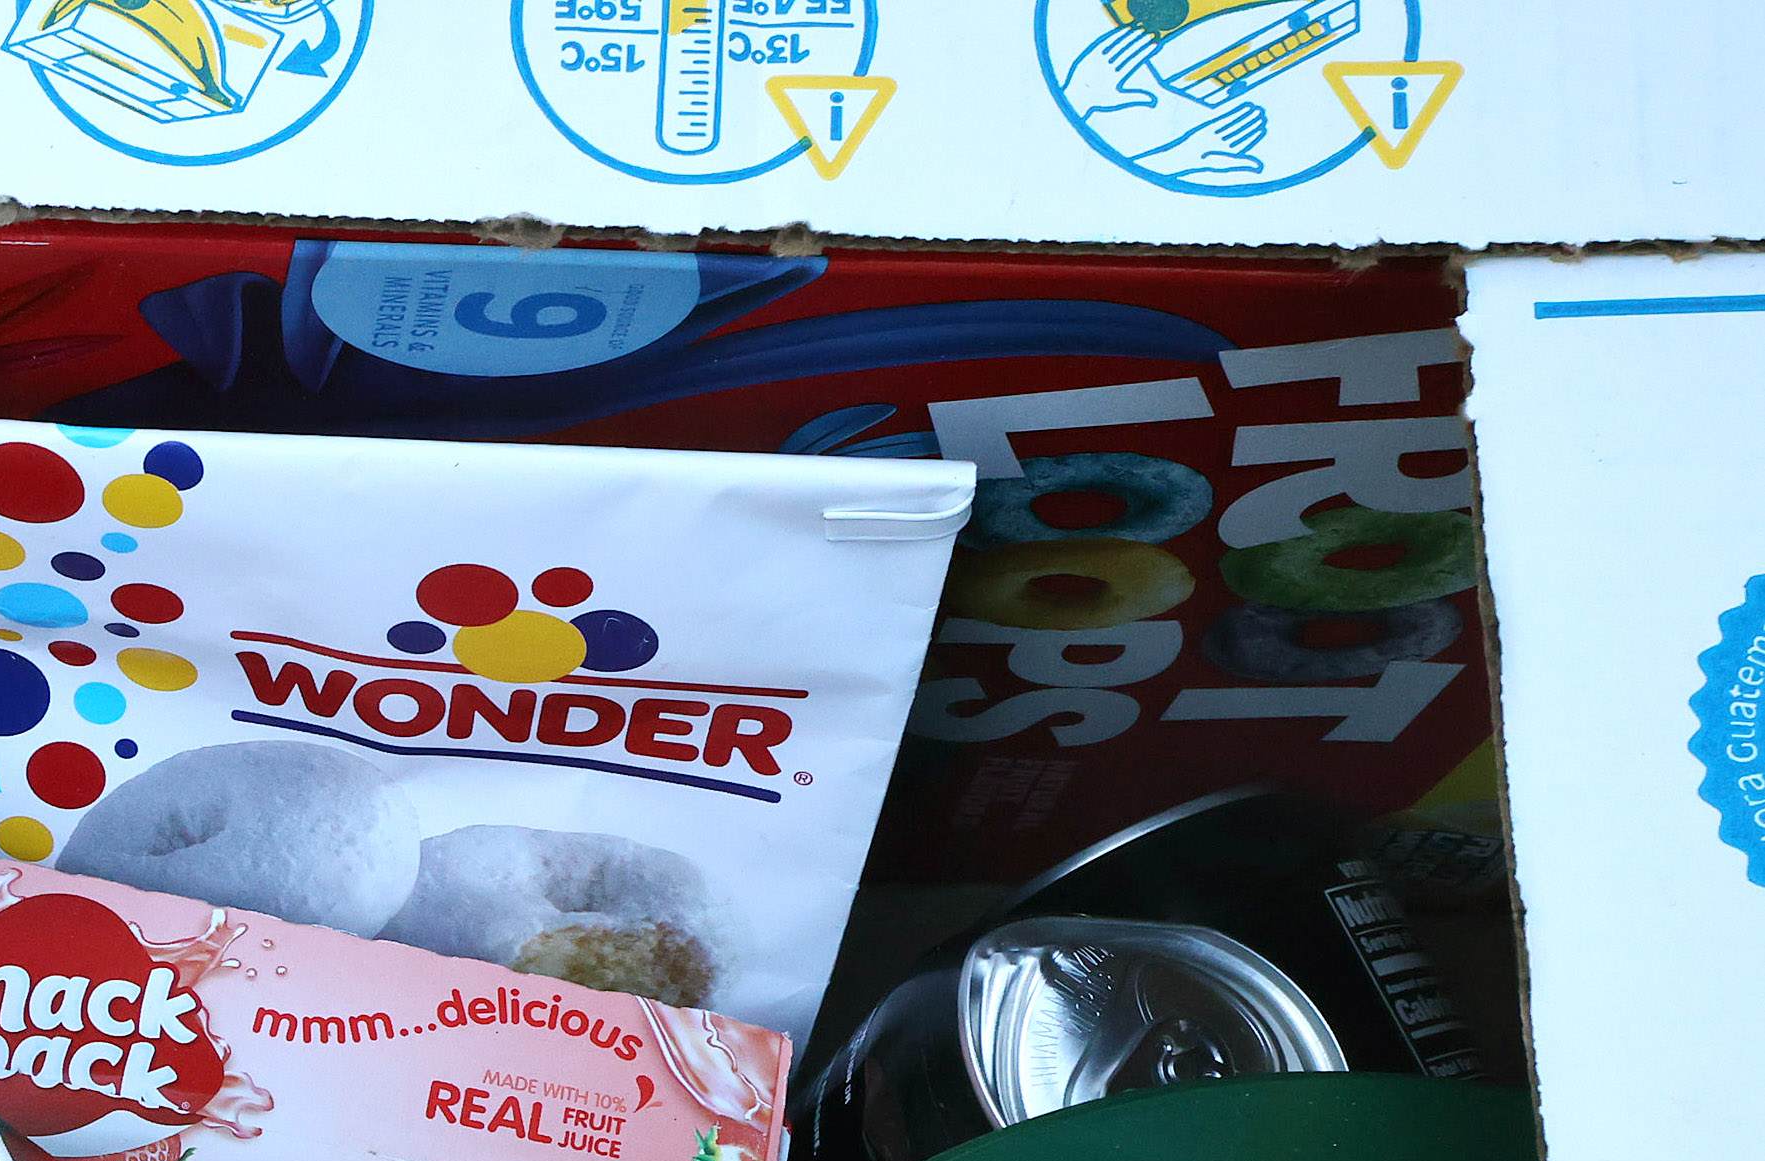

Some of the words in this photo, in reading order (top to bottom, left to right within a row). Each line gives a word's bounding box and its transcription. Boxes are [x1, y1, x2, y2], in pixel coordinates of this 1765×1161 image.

[561, 41, 645, 73] 15°C
[728, 32, 810, 64] 13°C
[372, 276, 403, 351] MINERALS
[412, 269, 452, 341] VITAMINS
[407, 342, 434, 352] &
[235, 651, 794, 776] WONDER
[482, 1068, 540, 1096] MADE
[542, 1081, 591, 1108] WITH
[593, 1090, 628, 1115] 10%
[425, 1080, 553, 1146] REAL
[561, 1106, 627, 1137] FRUIT
[556, 1129, 622, 1160] JUICE
